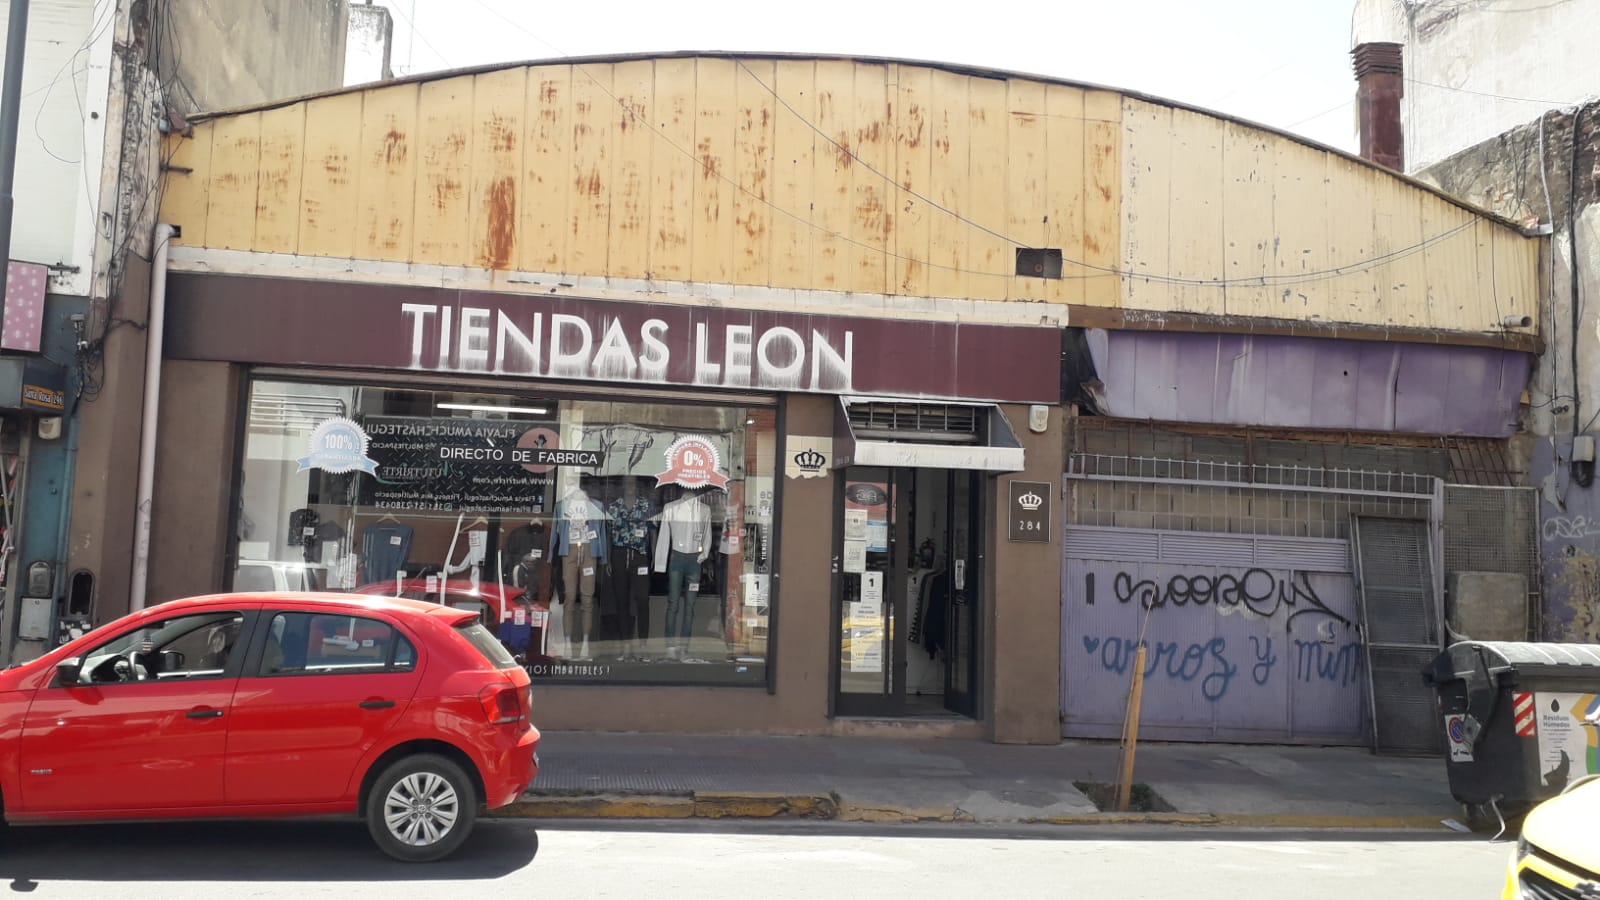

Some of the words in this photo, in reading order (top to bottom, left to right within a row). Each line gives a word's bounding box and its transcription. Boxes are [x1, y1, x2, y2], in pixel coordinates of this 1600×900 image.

[402, 303, 670, 372] TIENDAS
[695, 322, 853, 389] LEON
[325, 433, 353, 450] 100%
[440, 447, 504, 461] DIRECTO
[512, 450, 531, 462] DE
[538, 451, 598, 465] FABRICA
[684, 450, 704, 466] 0%
[1019, 520, 1041, 531] 284
